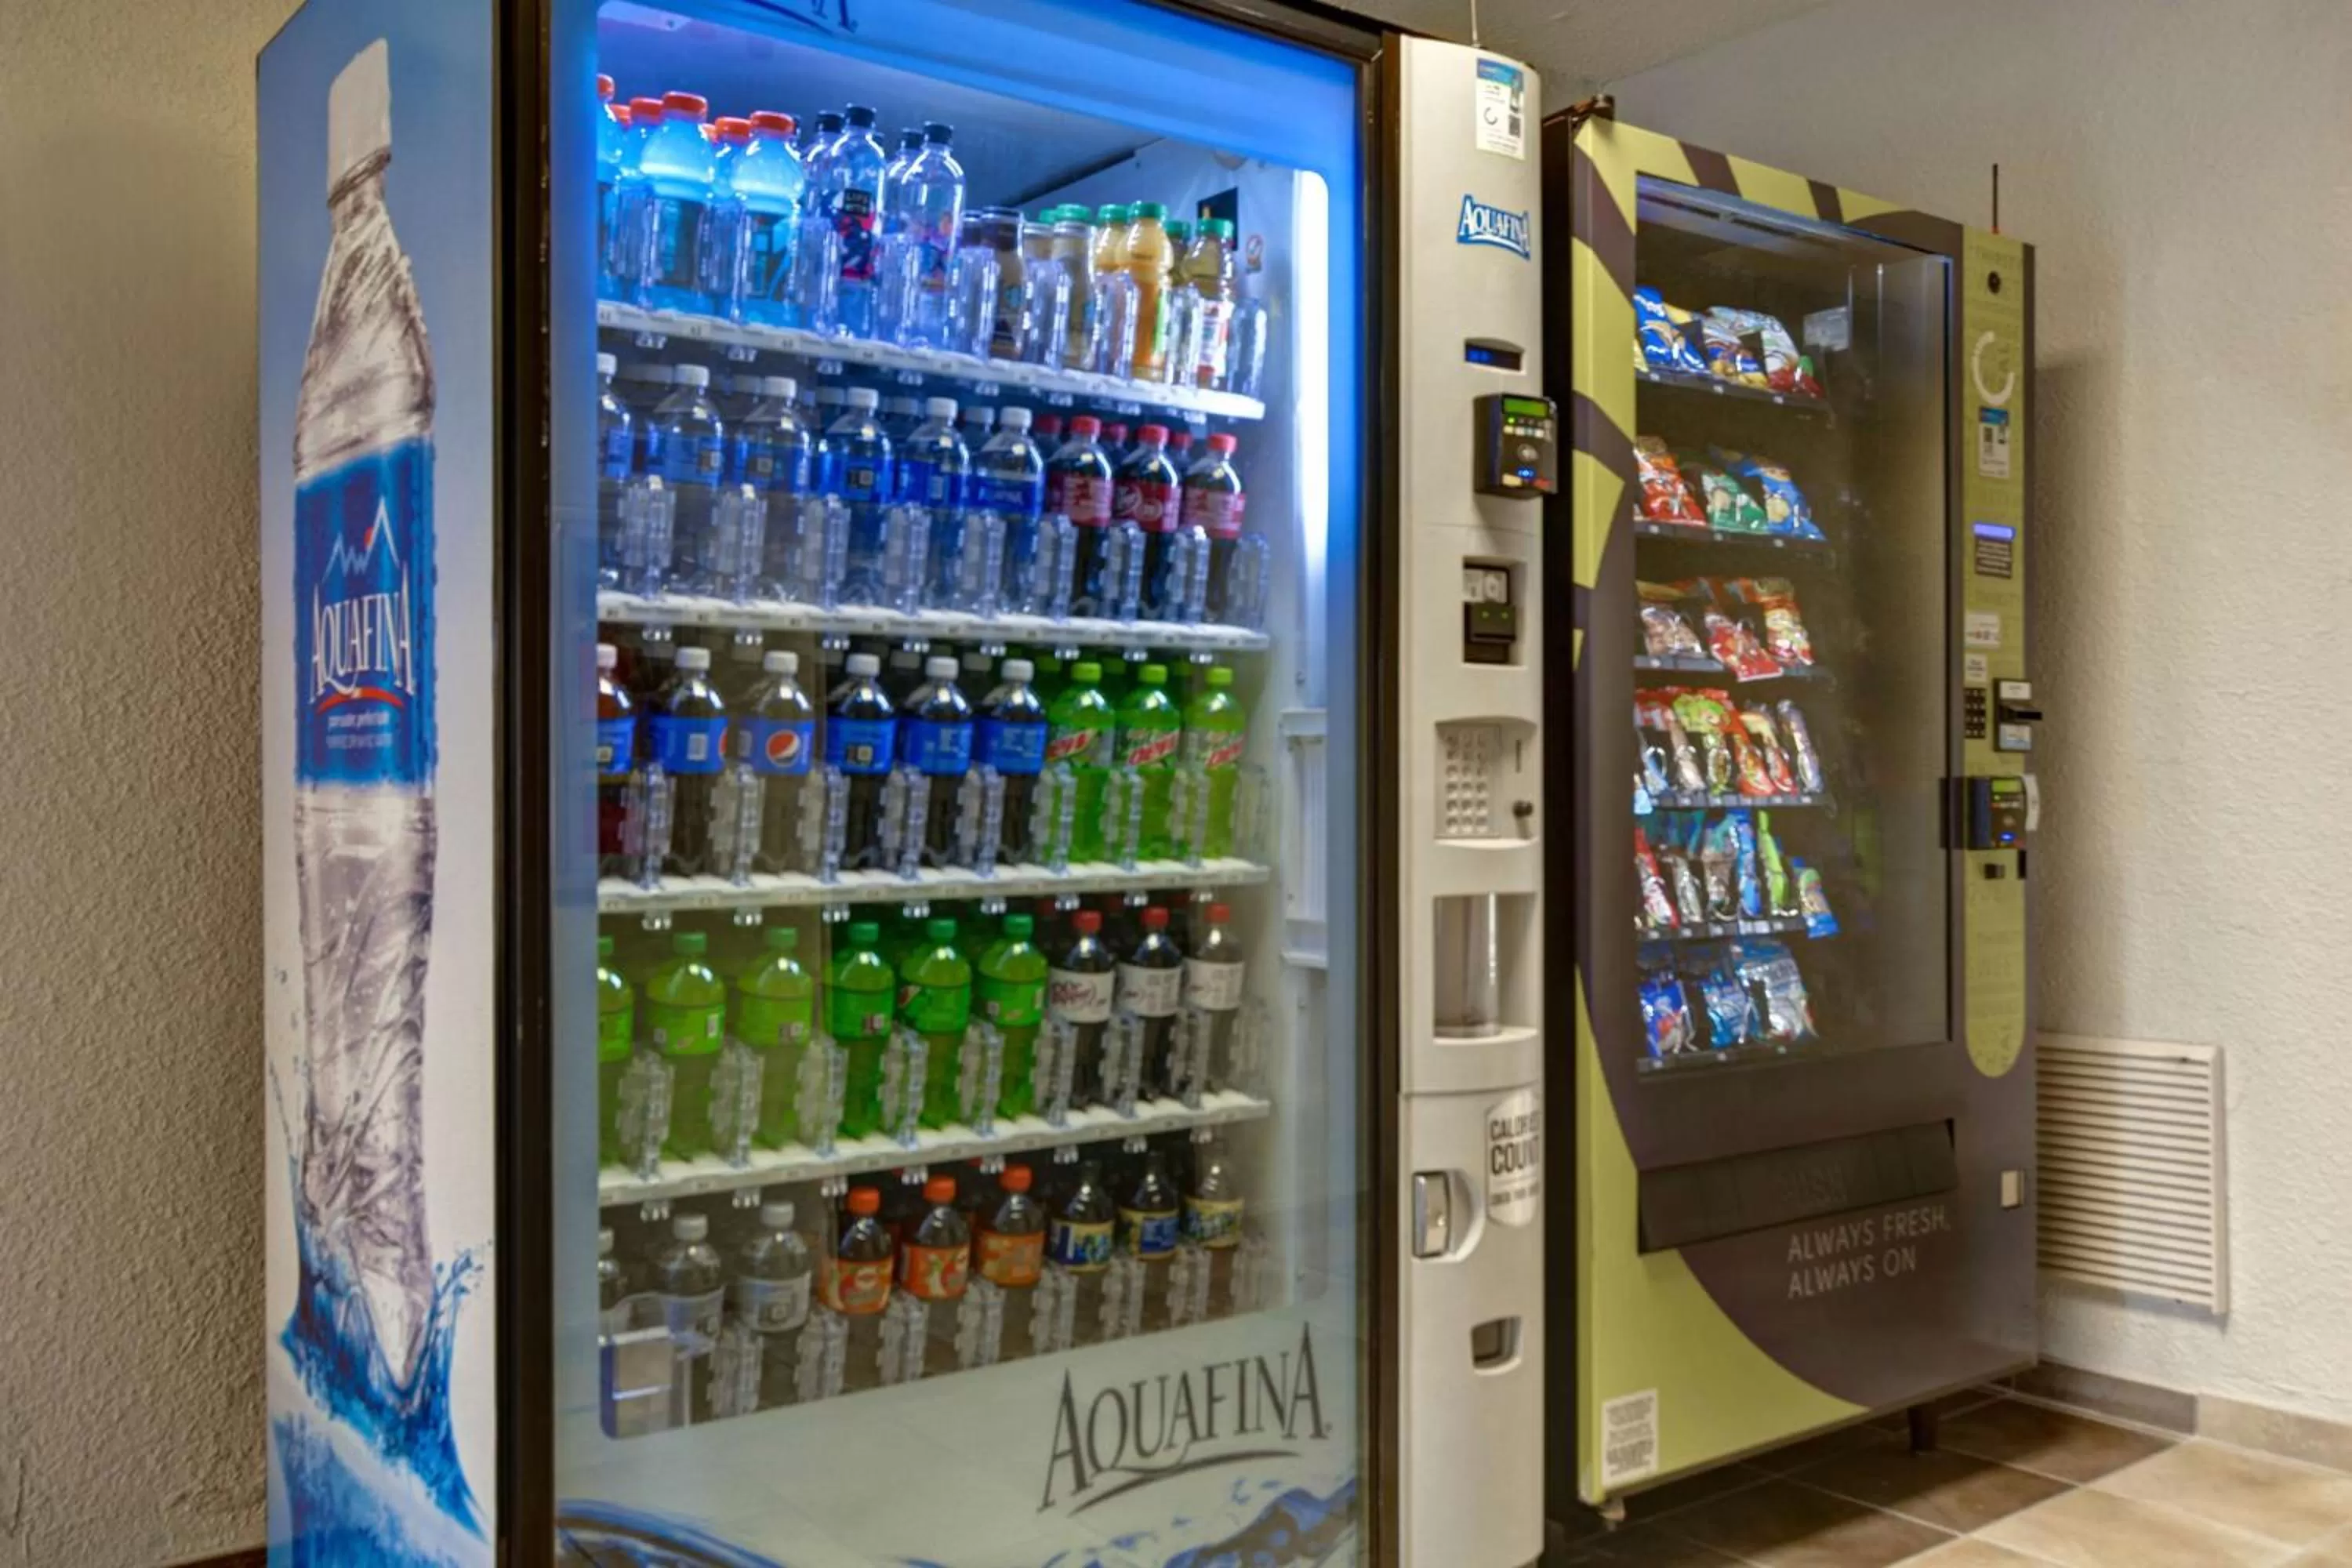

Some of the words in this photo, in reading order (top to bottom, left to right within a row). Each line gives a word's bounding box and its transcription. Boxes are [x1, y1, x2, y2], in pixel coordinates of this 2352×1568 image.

[1459, 196, 1530, 252] AQUAFINA
[309, 561, 416, 704] AQUAFINA
[1788, 1218, 1875, 1263] ALWAYS
[1788, 1254, 1875, 1299] ALWAYS
[1882, 1246, 1916, 1277] ON
[1037, 1321, 1328, 1512] AQUAFINA
